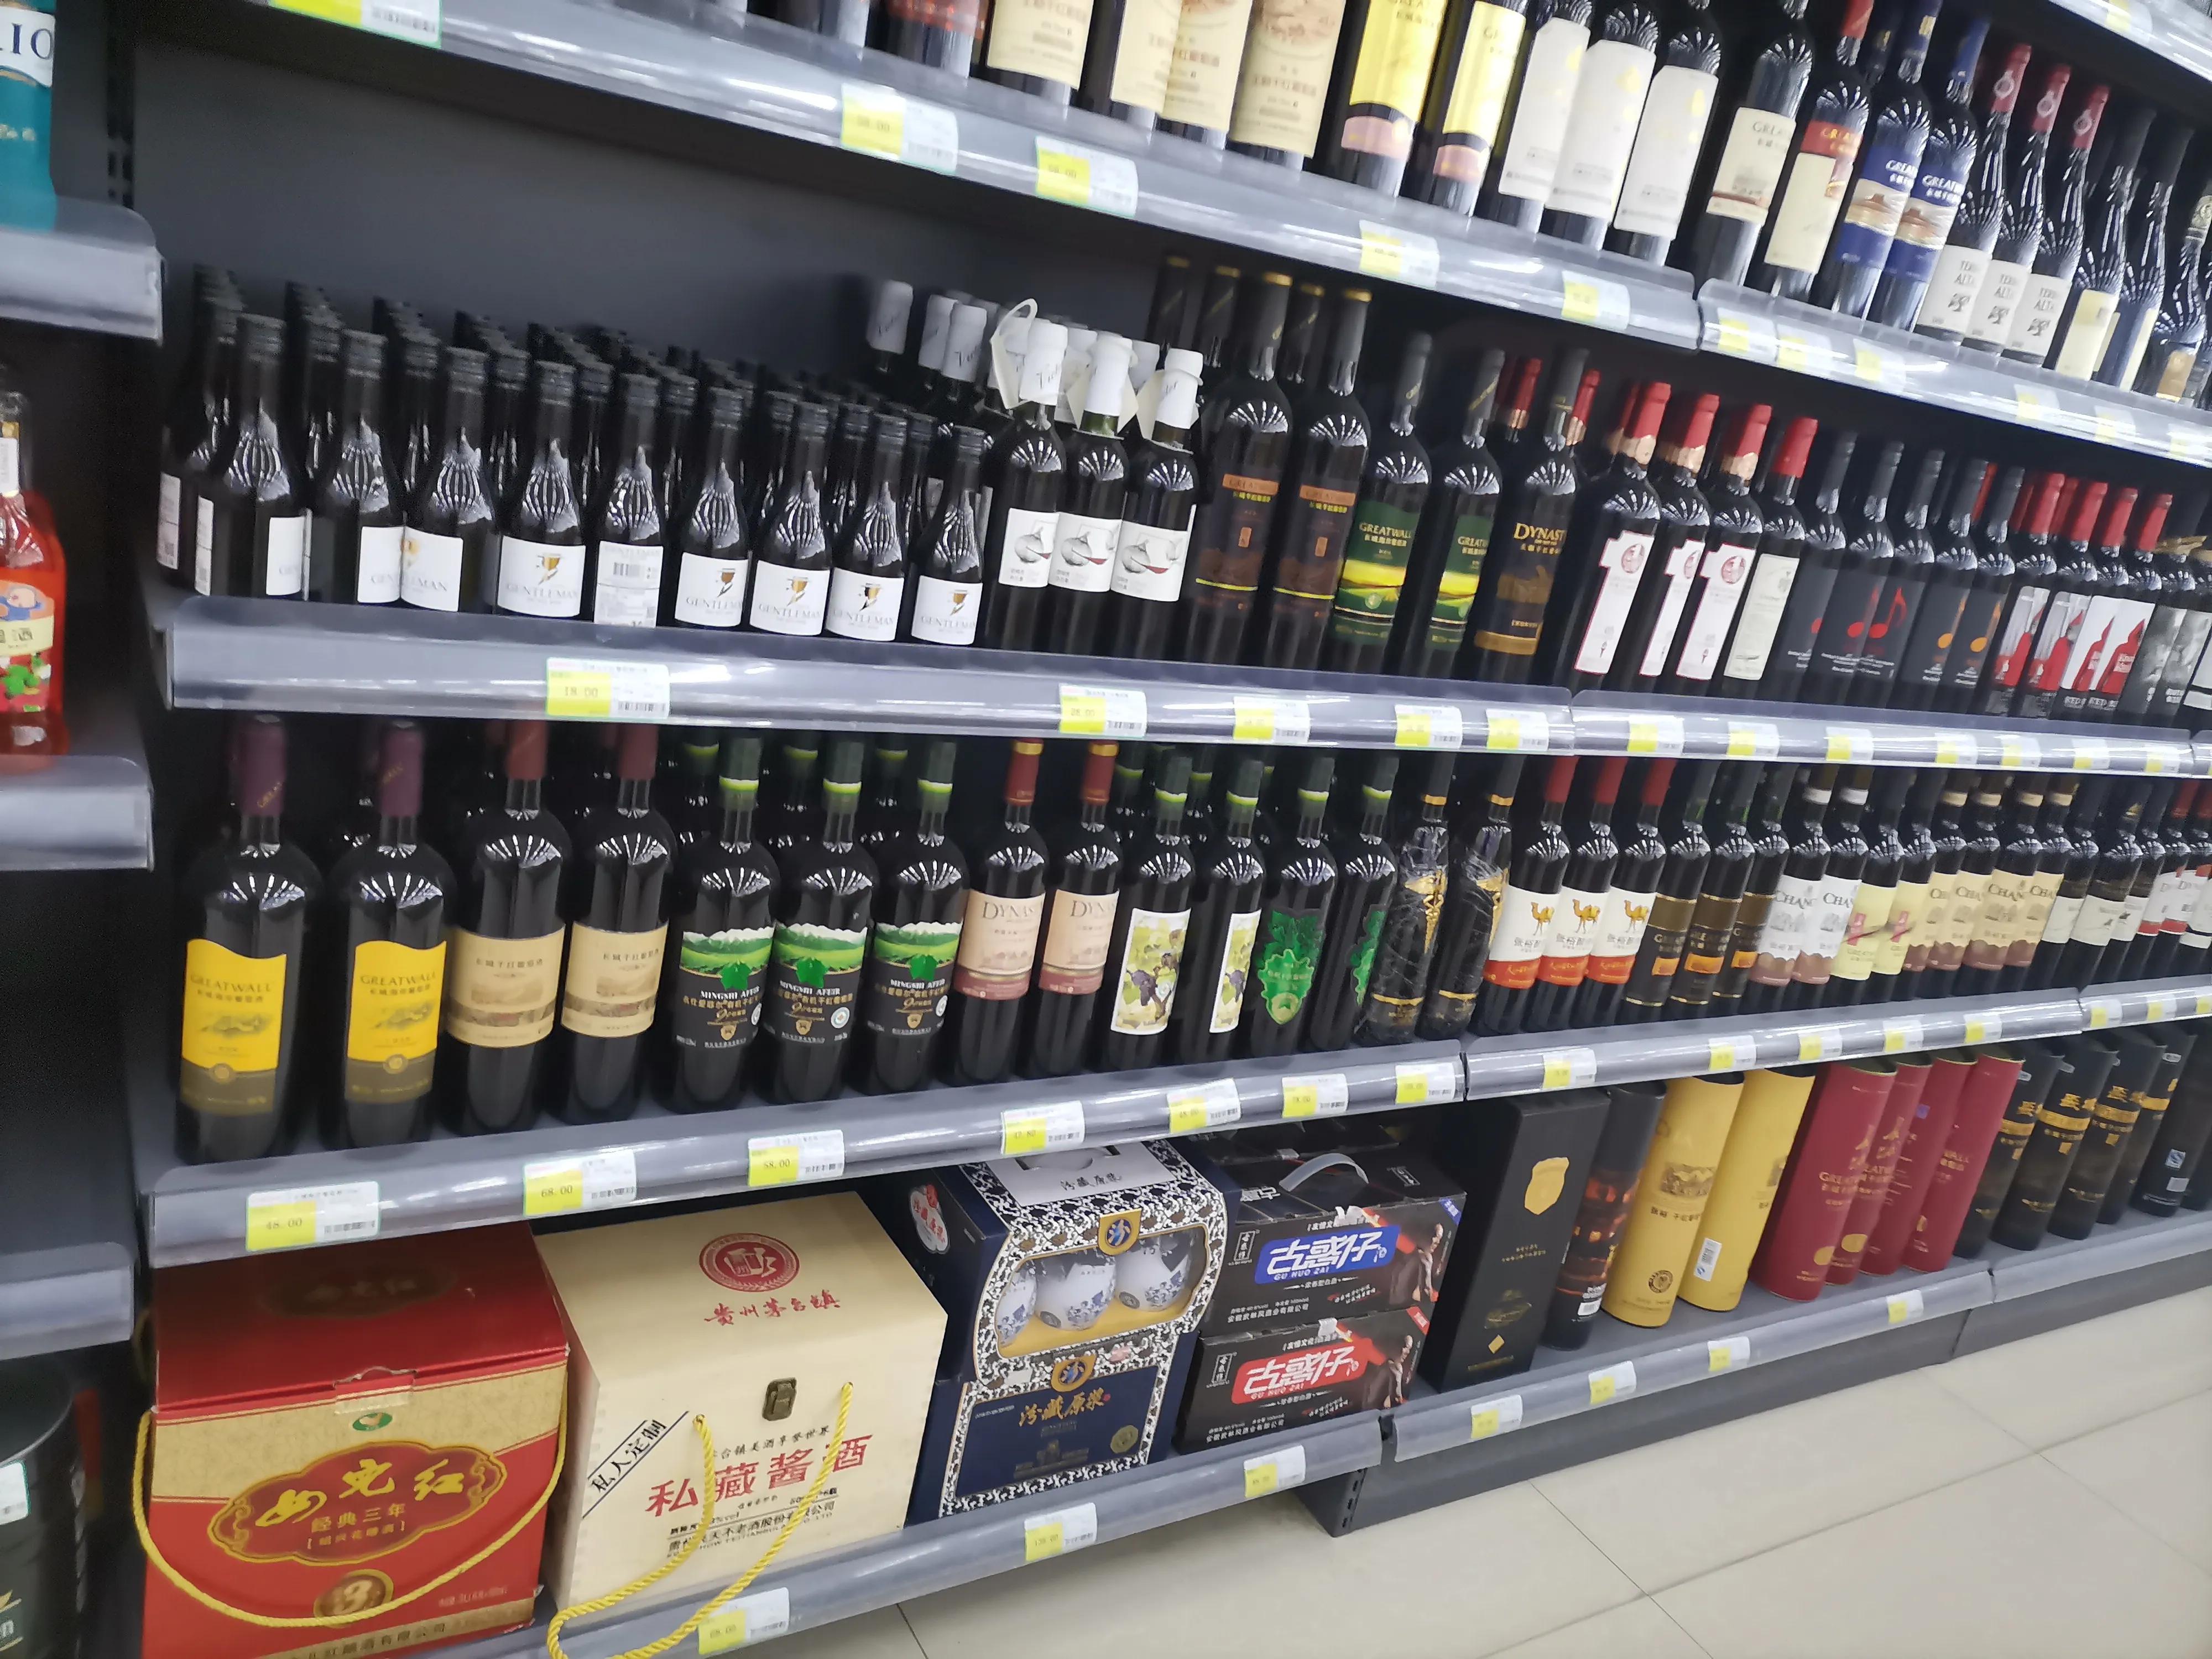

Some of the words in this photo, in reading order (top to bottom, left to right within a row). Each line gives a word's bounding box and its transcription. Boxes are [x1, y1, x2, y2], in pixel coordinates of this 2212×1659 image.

[0, 23, 54, 60] IO
[361, 971, 436, 987] GREATWALL
[1266, 1230, 1383, 1276] 古惑仔
[1244, 1345, 1355, 1395] 古惑仔
[590, 1419, 667, 1493] 私人定制
[645, 1434, 874, 1517] 私藏酱酒
[311, 1503, 405, 1533] 经典三年
